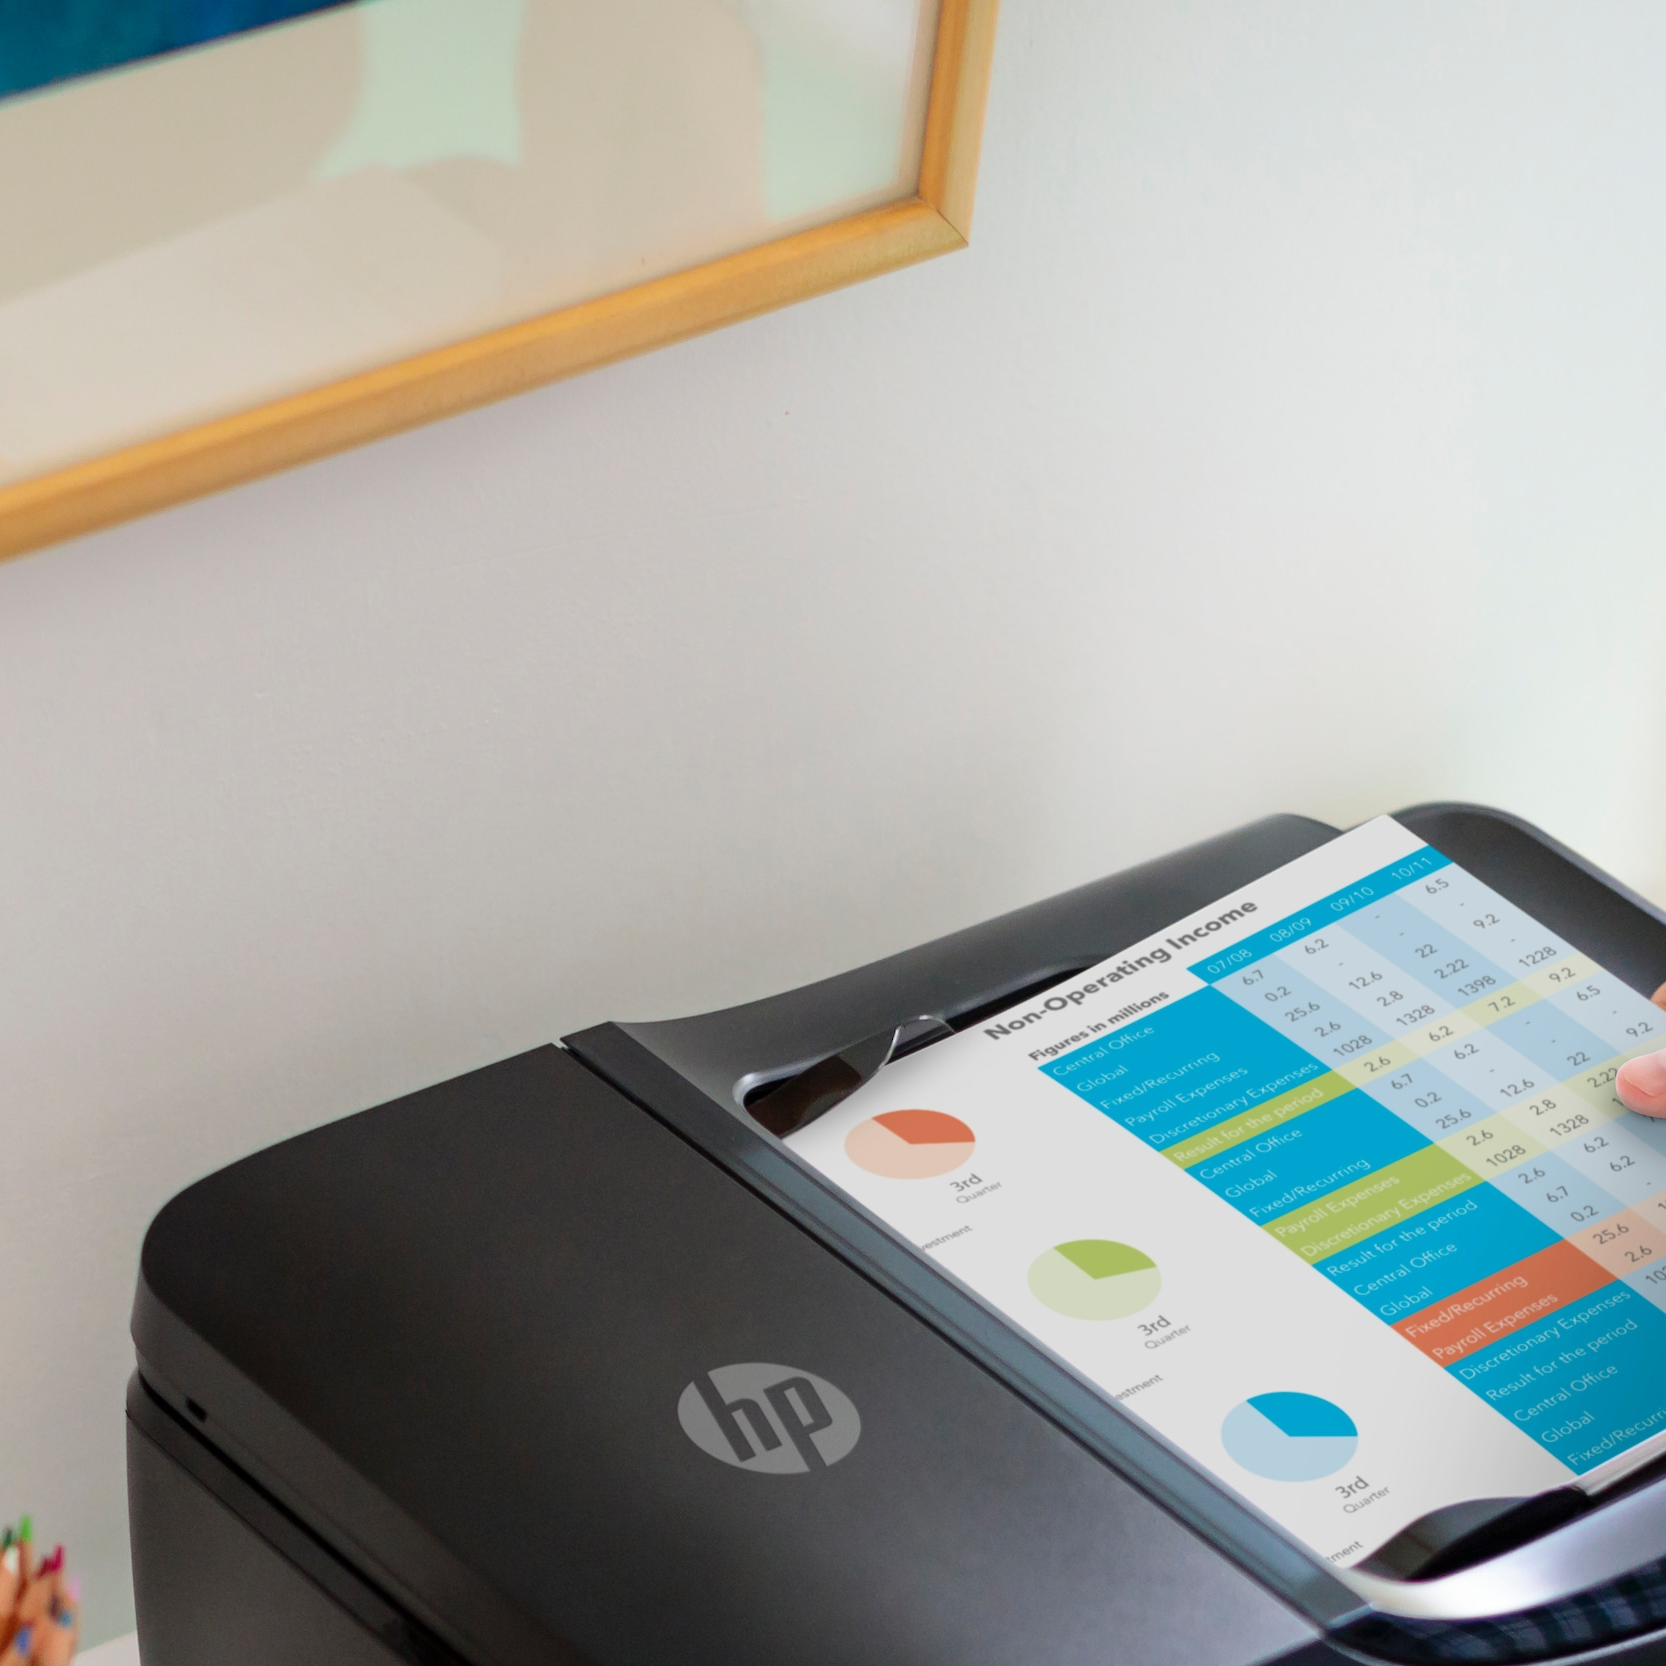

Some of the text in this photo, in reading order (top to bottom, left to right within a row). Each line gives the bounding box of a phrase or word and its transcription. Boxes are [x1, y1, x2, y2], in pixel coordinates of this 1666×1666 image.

[981, 901, 1258, 1041] Non-Operating Income
[1206, 856, 1432, 974] 07/08 08/09 09/10 10/11
[1027, 991, 1170, 1061] Figures in millions
[1051, 877, 1450, 1076] Central Office 6.7 6.2 6.5
[1098, 912, 1500, 1110] Fixed/Recurring 25.6 12.6 22 9.2
[1075, 985, 1292, 1092] Global 0.2
[1123, 957, 1470, 1127] Payroll Expenses 2.6 2.8 2.22
[1147, 945, 1557, 1145] Discretionary Expenses 1028 1328 1398 1228
[1172, 966, 1576, 1163] Result for the period 2.6 6.2 7.2 9.2
[1198, 984, 1601, 1179] Central Office 6.7 6.2 6.5
[1223, 1090, 1443, 1198] Global 0.2
[1248, 1021, 1654, 1218] Fixed/Recurring 25.6 12.6 22 9.2
[1273, 1207, 1329, 1238] Payroll
[1324, 1175, 1400, 1213] Expenses
[1465, 1128, 1494, 1147] 2.6
[1528, 1098, 1557, 1116] 2.8
[948, 1172, 983, 1192] 3rd
[954, 1180, 1002, 1204] Quarter
[1299, 1113, 1590, 1258] Discretionary Expenses 1028 1328
[1325, 1135, 1609, 1277] Result for the period 2.6 6.2
[1352, 1263, 1412, 1296] Central
[1409, 1243, 1458, 1269] Office
[1545, 1184, 1569, 1203] 6.7
[1608, 1154, 1636, 1172] 6.2
[1379, 1204, 1599, 1317] Global 0.2
[1404, 1275, 1529, 1338] Fixed/Recurring
[1591, 1222, 1630, 1245] 25.6
[1430, 1326, 1487, 1360] Payroll
[1482, 1293, 1558, 1334] Expenses
[1623, 1244, 1653, 1263] 2.6
[1136, 1314, 1172, 1337] 3rd
[1143, 1324, 1191, 1350] Quarter
[1457, 1326, 1561, 1381] Discretionary
[1556, 1291, 1631, 1330] Expenses
[1484, 1372, 1537, 1401] Result
[1532, 1360, 1558, 1376] for
[1557, 1347, 1587, 1364] the
[1585, 1317, 1638, 1353] period
[691, 1370, 835, 1472] hp
[1512, 1386, 1572, 1422] Central
[1569, 1365, 1618, 1392] Office
[1540, 1409, 1596, 1443] Global
[1334, 1474, 1370, 1499] 3rd
[1342, 1485, 1390, 1514] Quarter
